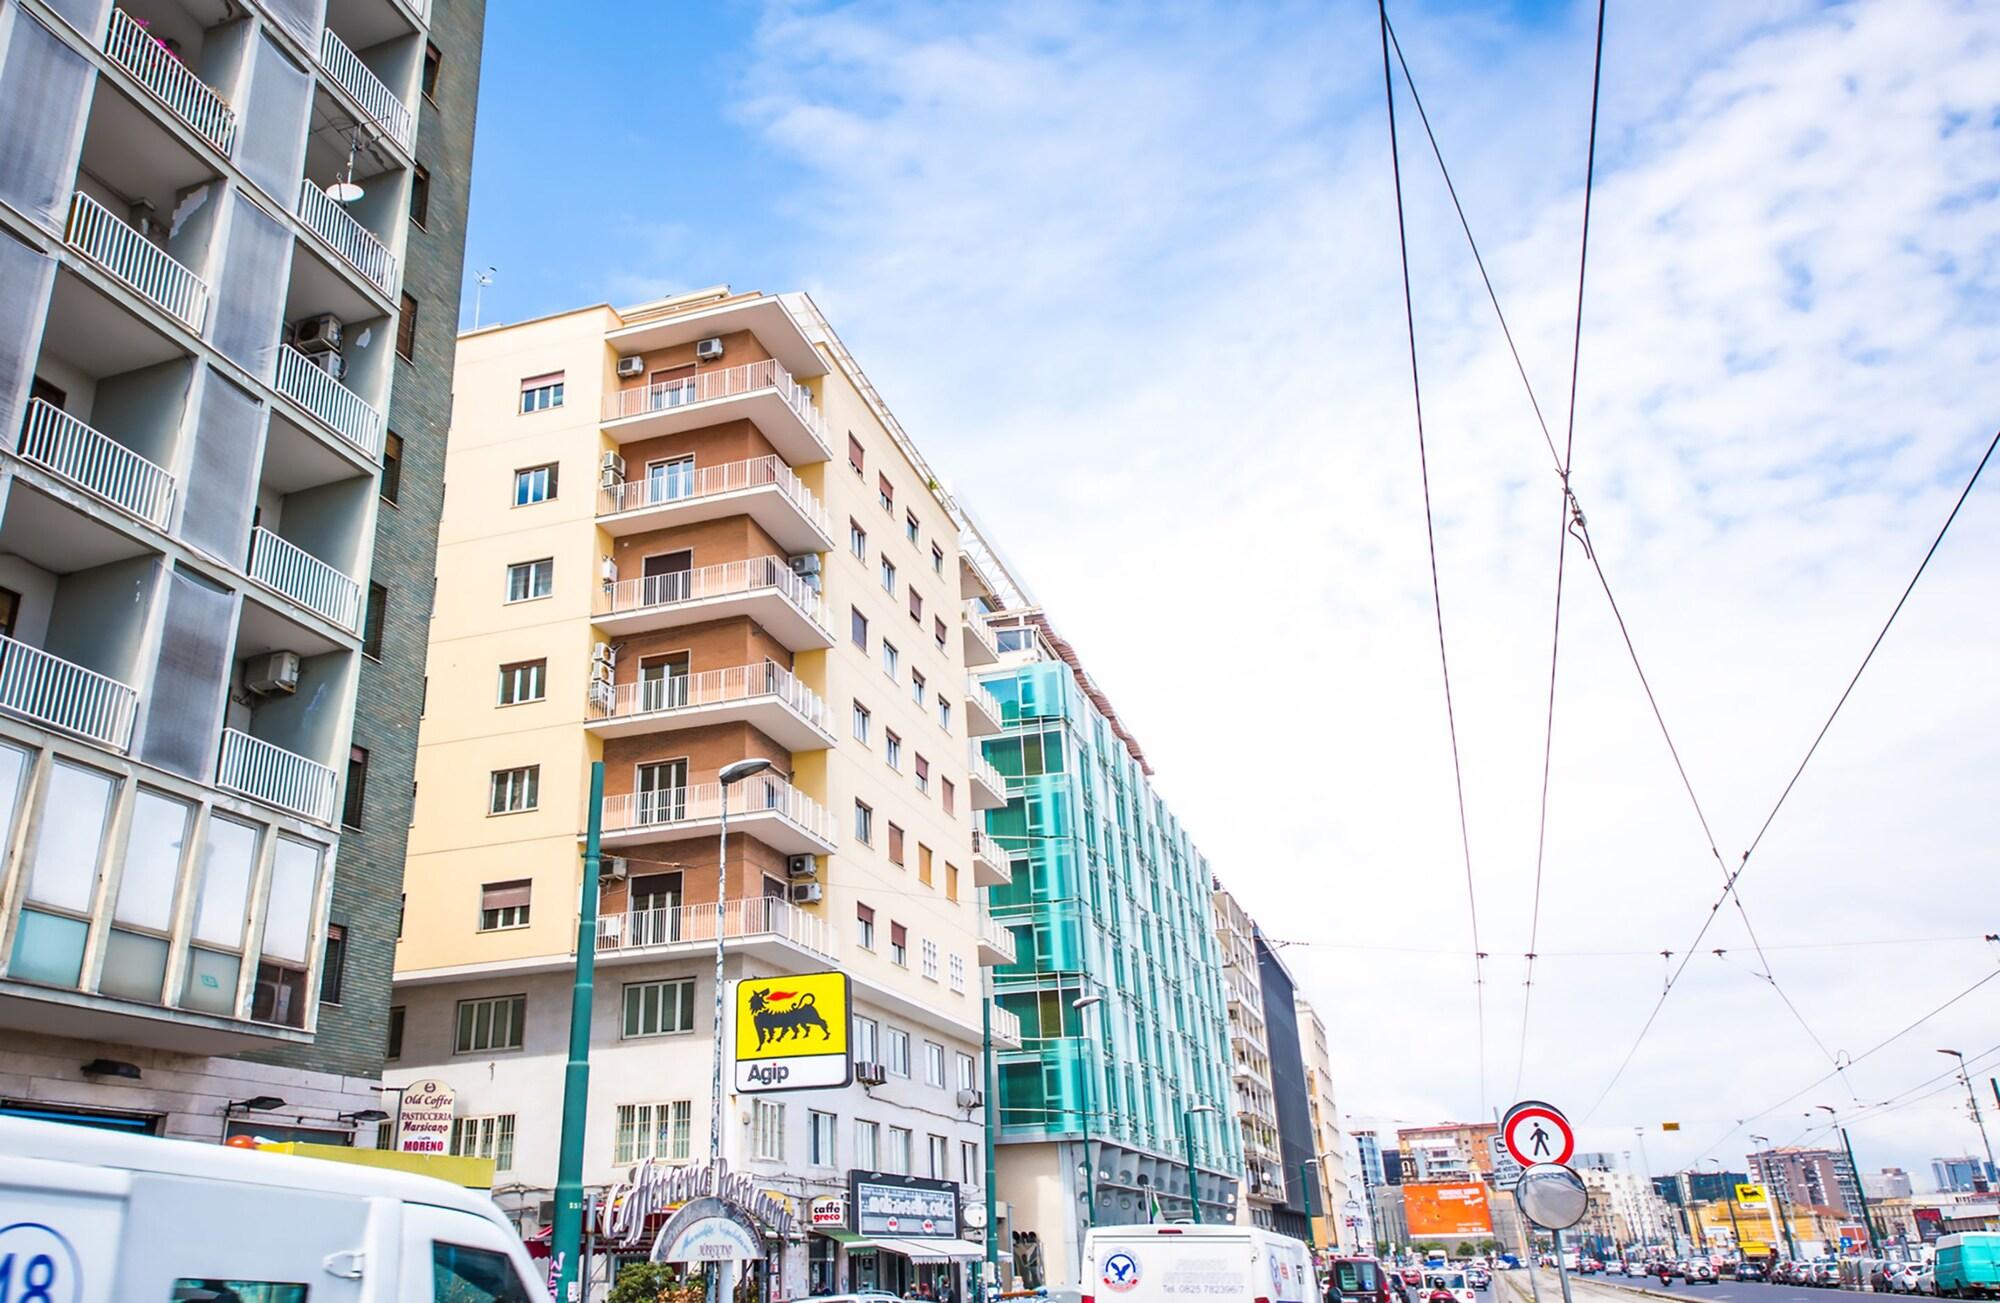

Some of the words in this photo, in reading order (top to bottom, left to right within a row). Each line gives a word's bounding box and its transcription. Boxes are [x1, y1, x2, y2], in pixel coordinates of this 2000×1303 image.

[747, 1063, 789, 1085] Agip
[404, 1094, 424, 1105] Old
[424, 1094, 453, 1109] Coffee
[401, 1112, 452, 1120] PASTICCERIA
[403, 1121, 449, 1134] Marsicano
[403, 1141, 444, 1152] MORENO
[814, 1214, 840, 1223] greco
